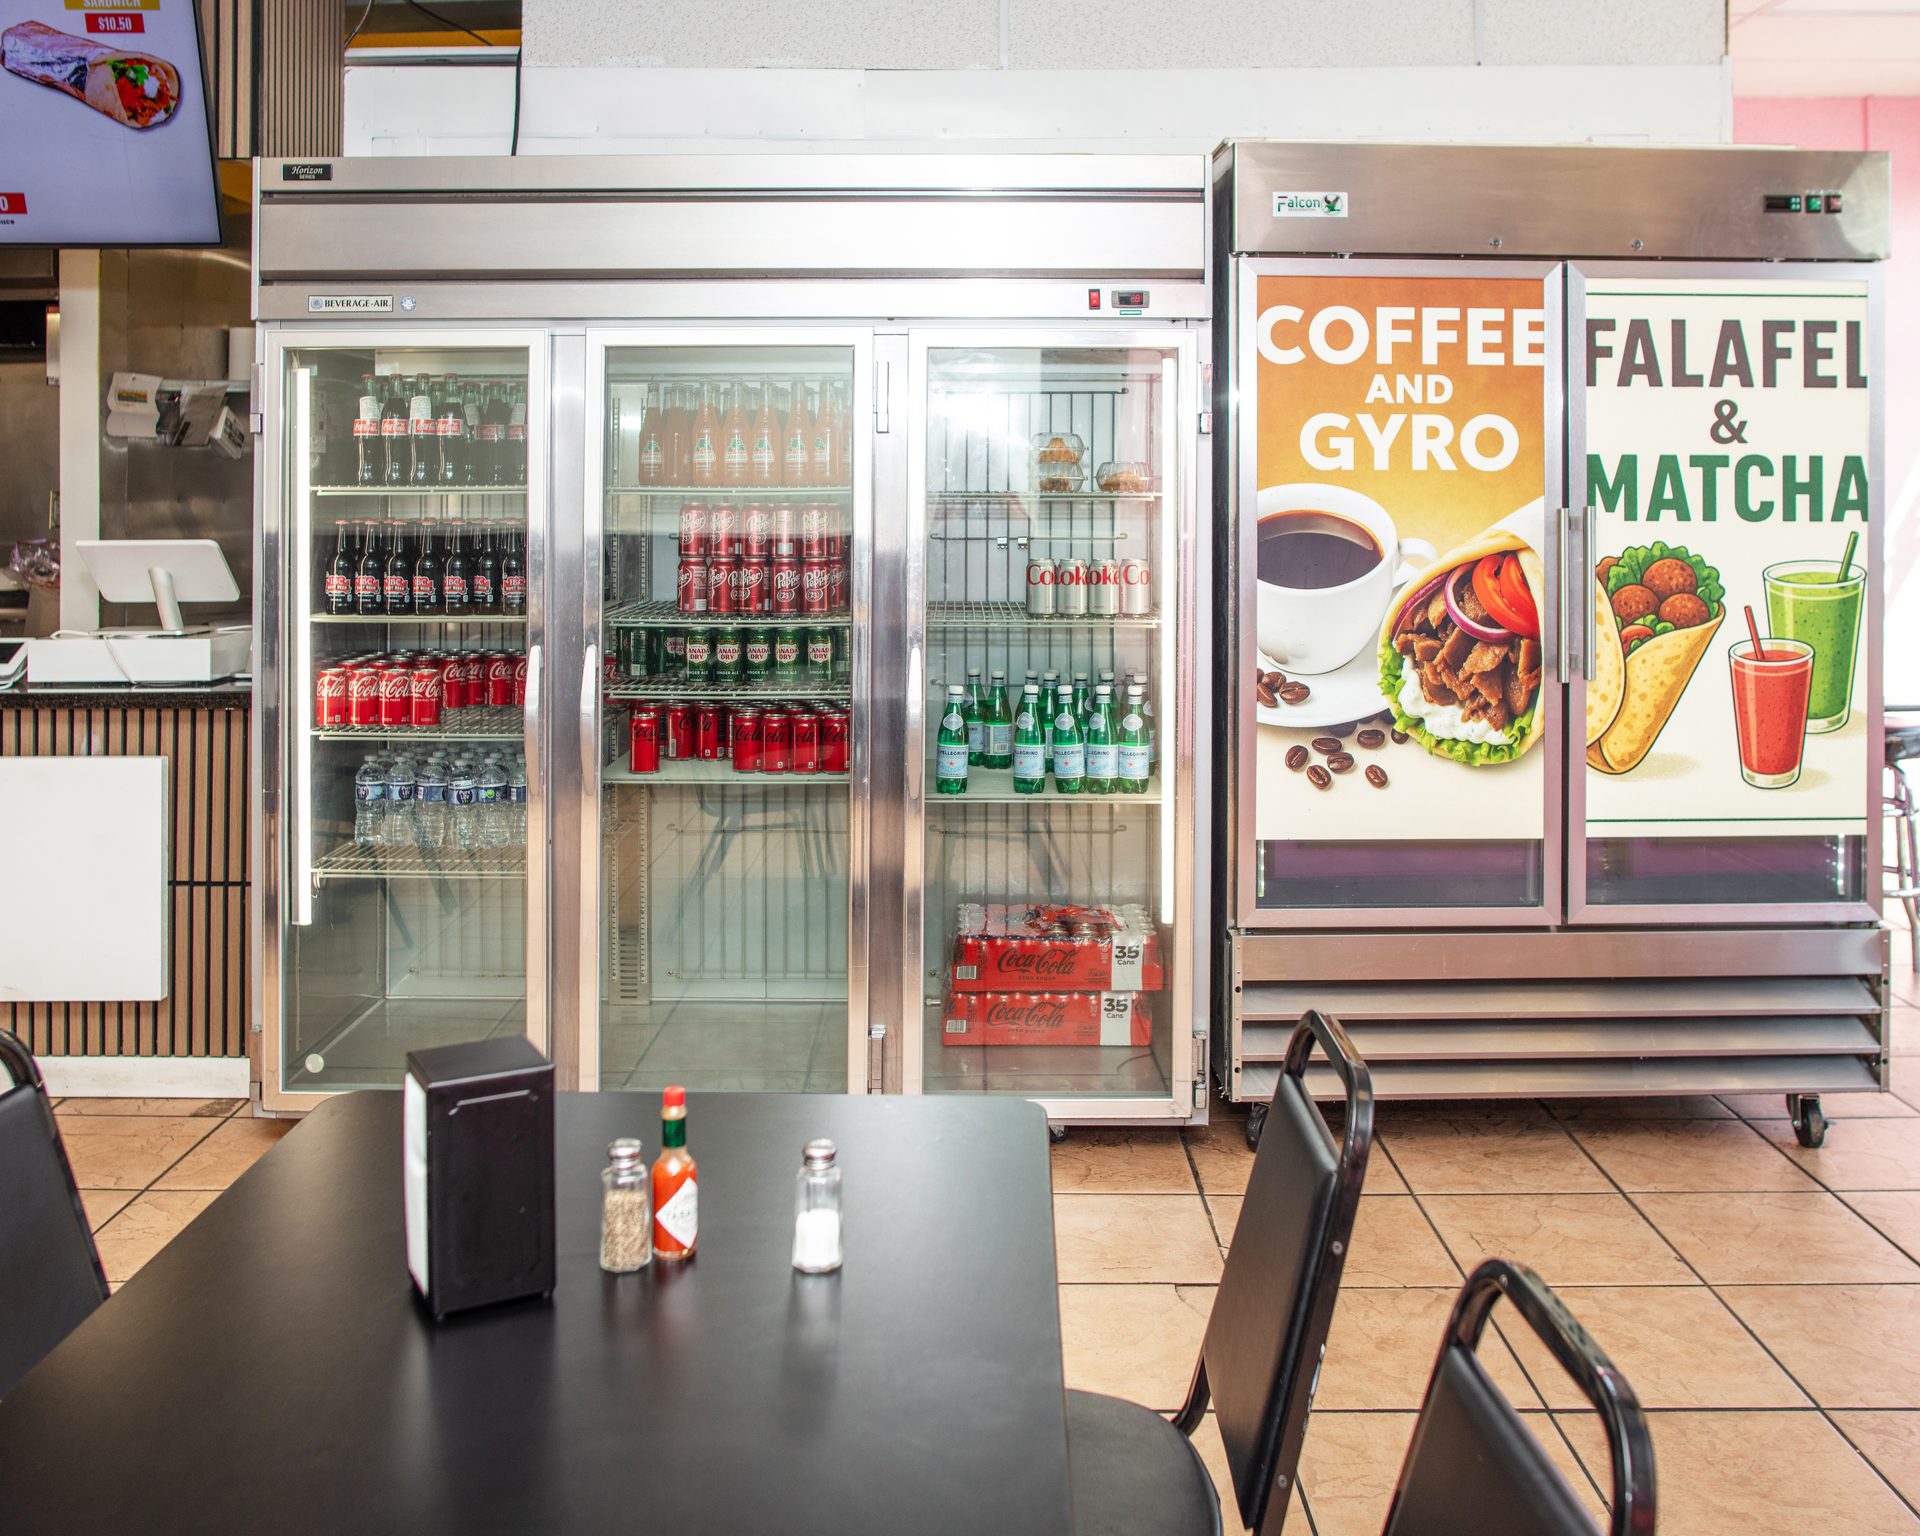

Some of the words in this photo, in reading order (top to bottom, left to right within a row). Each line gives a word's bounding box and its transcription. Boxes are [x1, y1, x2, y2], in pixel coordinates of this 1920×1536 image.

[98, 16, 132, 31] $10.50
[291, 165, 323, 175] Horizon
[1277, 195, 1321, 212] Falcon
[1257, 305, 1545, 366] COFFEE
[1586, 318, 1868, 388] FALAFEL
[1364, 373, 1454, 404] AND
[1710, 399, 1748, 444] &
[1299, 412, 1520, 472] GYRO
[1586, 453, 1868, 523] MATCHA
[1115, 945, 1140, 960] 35
[1103, 998, 1129, 1013] 35
